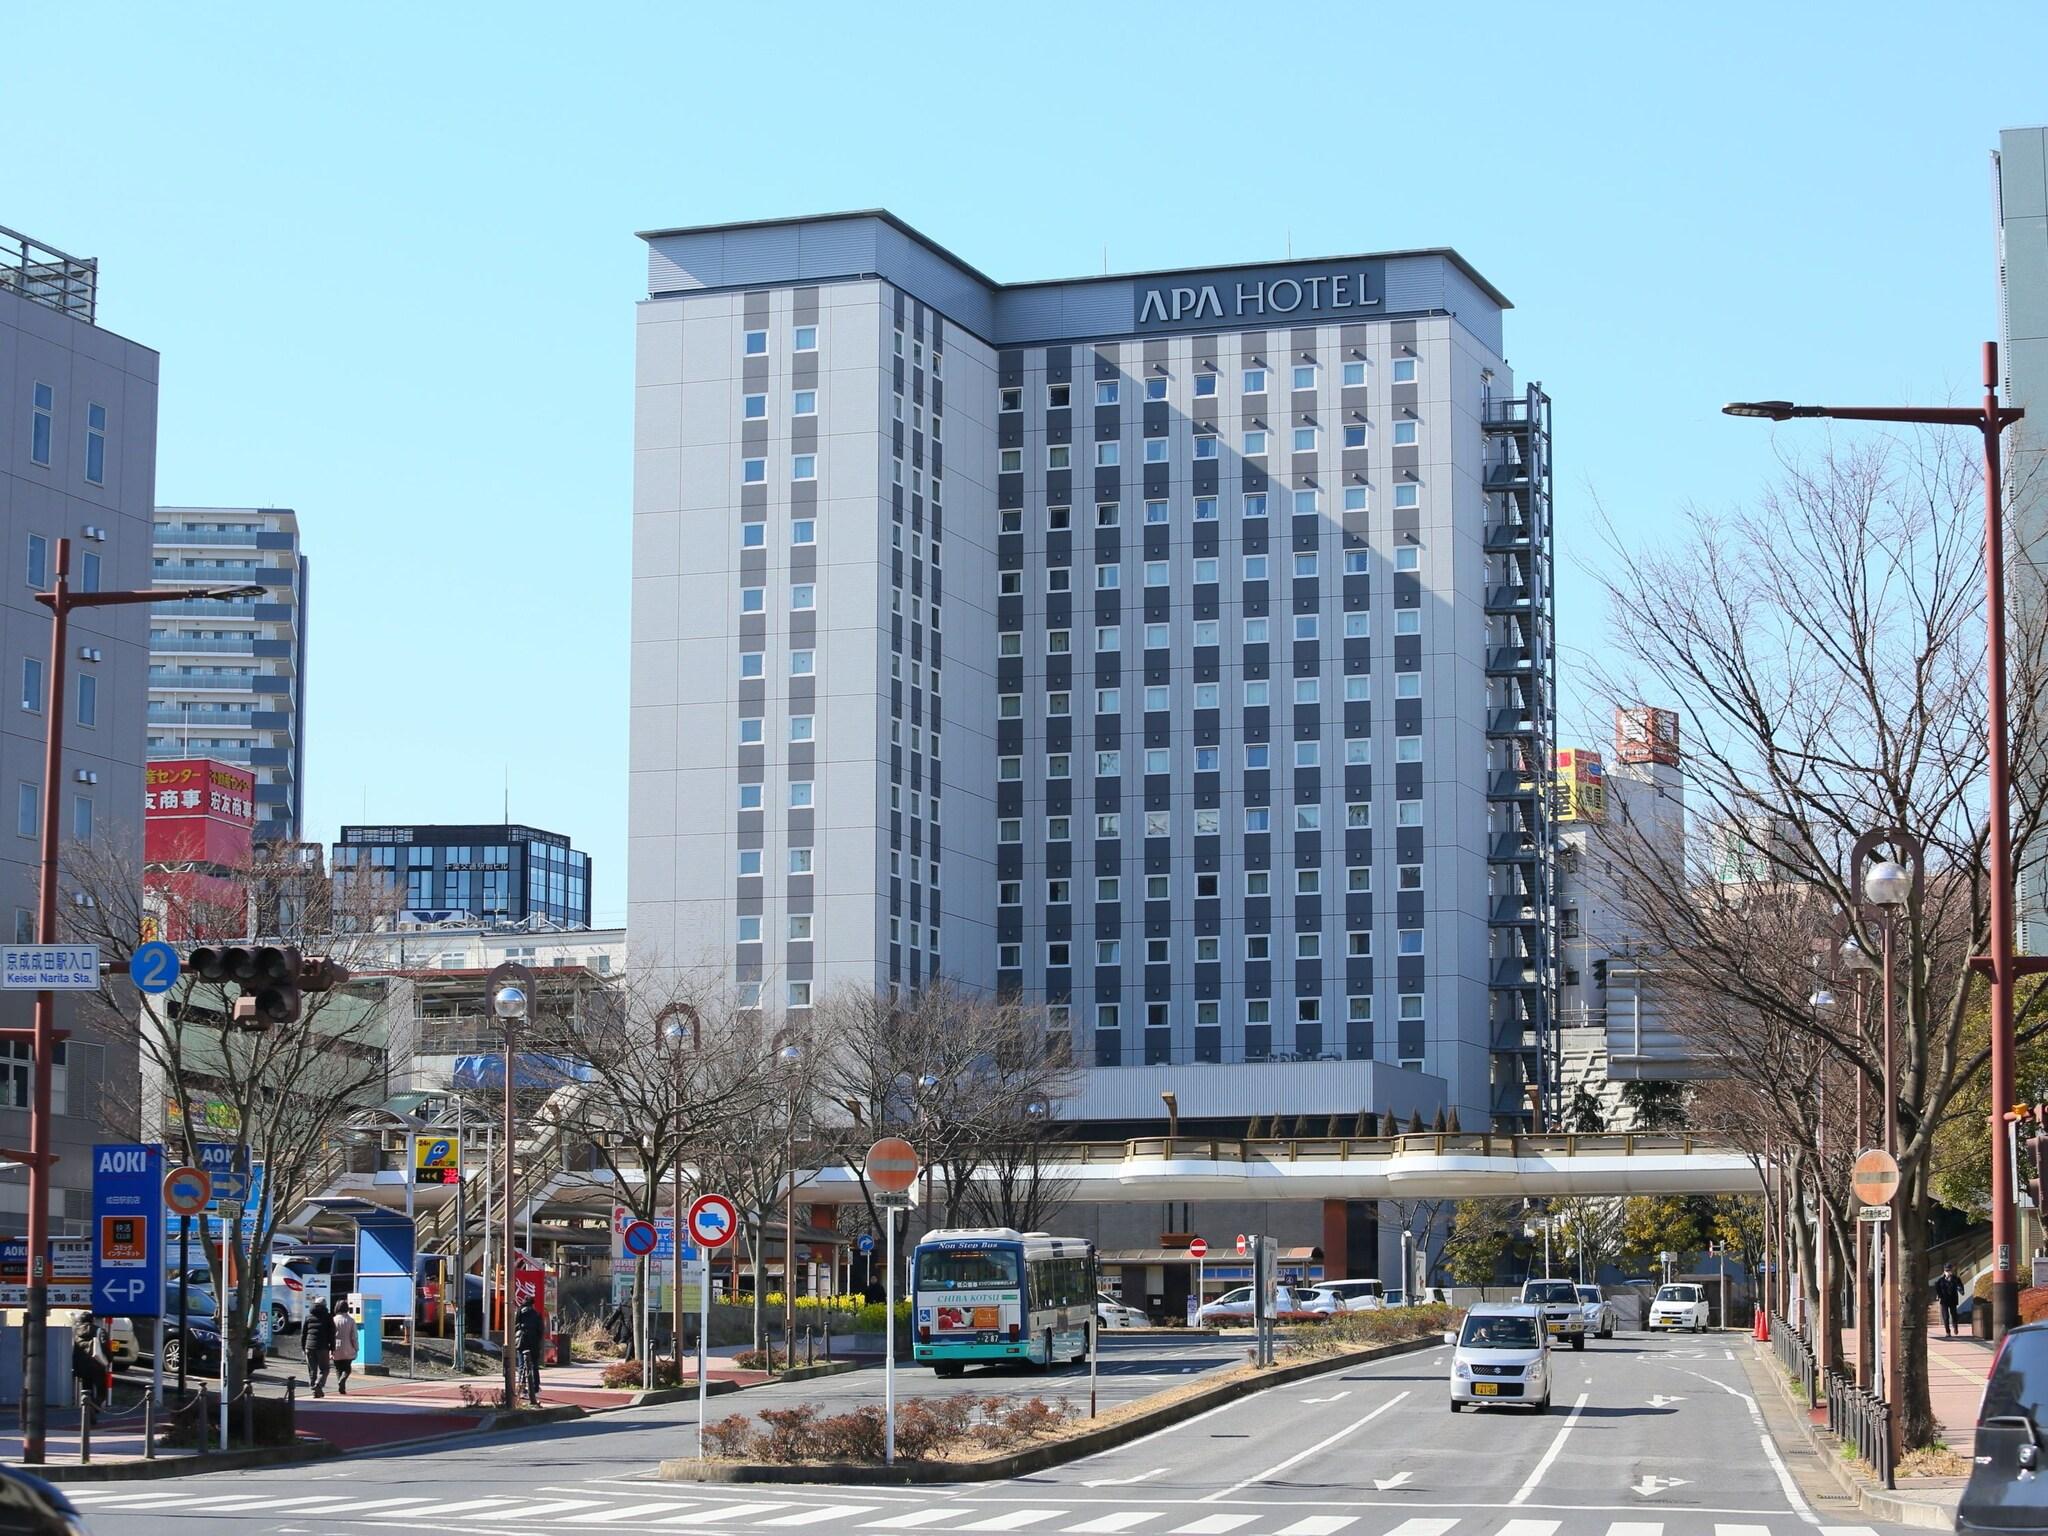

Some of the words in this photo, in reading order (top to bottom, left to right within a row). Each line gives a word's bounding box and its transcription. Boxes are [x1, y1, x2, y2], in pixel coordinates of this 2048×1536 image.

[1140, 285, 1224, 322] APA
[1236, 273, 1380, 315] HOTEL
[7, 952, 92, 970] 京成成田駅入口
[143, 948, 167, 986] 2
[7, 973, 37, 983] Keisei
[40, 973, 69, 983] Narita
[73, 973, 92, 983] Sta.
[98, 1151, 147, 1173] AOKI
[129, 1279, 145, 1302] P
[938, 1295, 967, 1303] CHIBA
